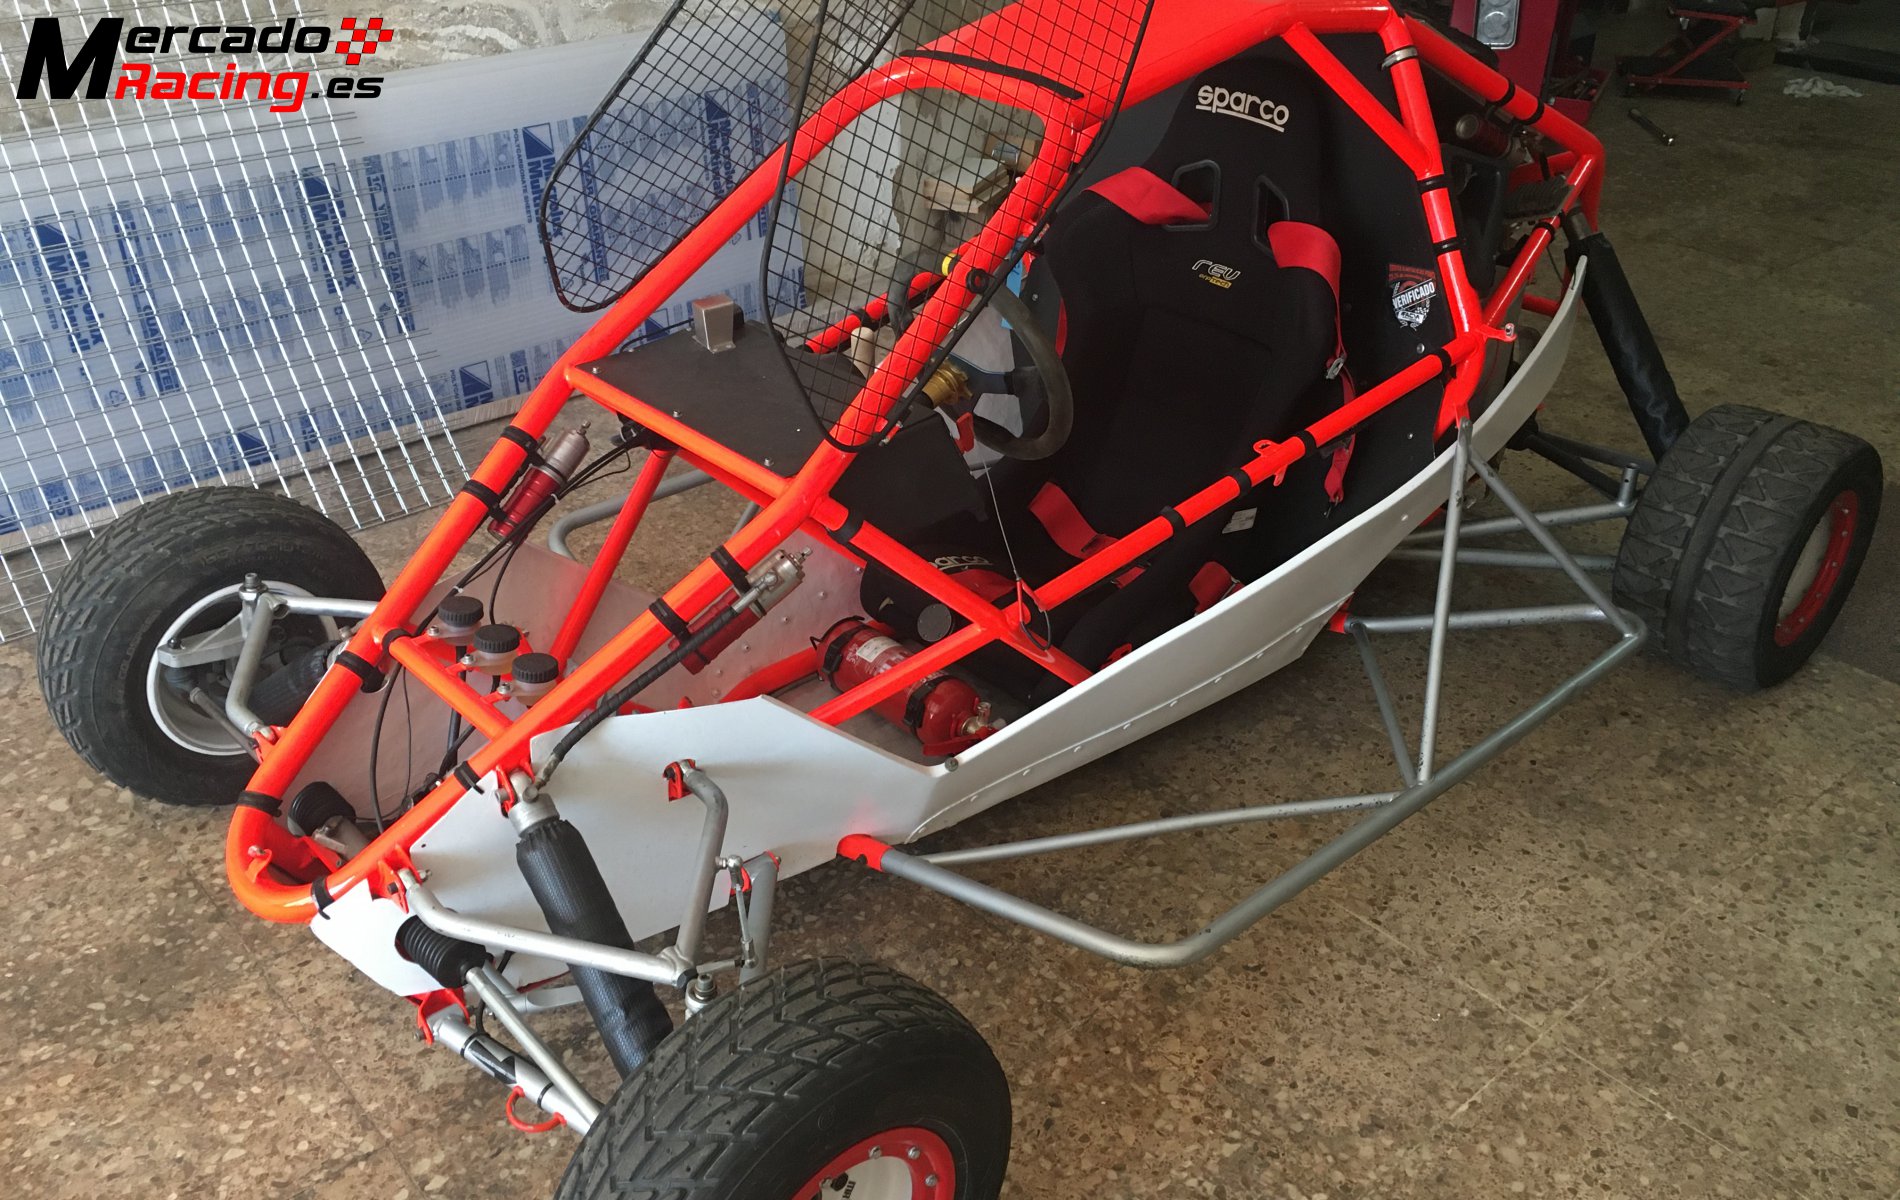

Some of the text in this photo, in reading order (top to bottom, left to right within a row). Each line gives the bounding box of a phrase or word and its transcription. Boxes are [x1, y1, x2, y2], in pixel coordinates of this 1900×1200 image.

[1197, 85, 1290, 127] sparco
[1392, 281, 1436, 309] VERIFICADO
[517, 368, 526, 383] 10
